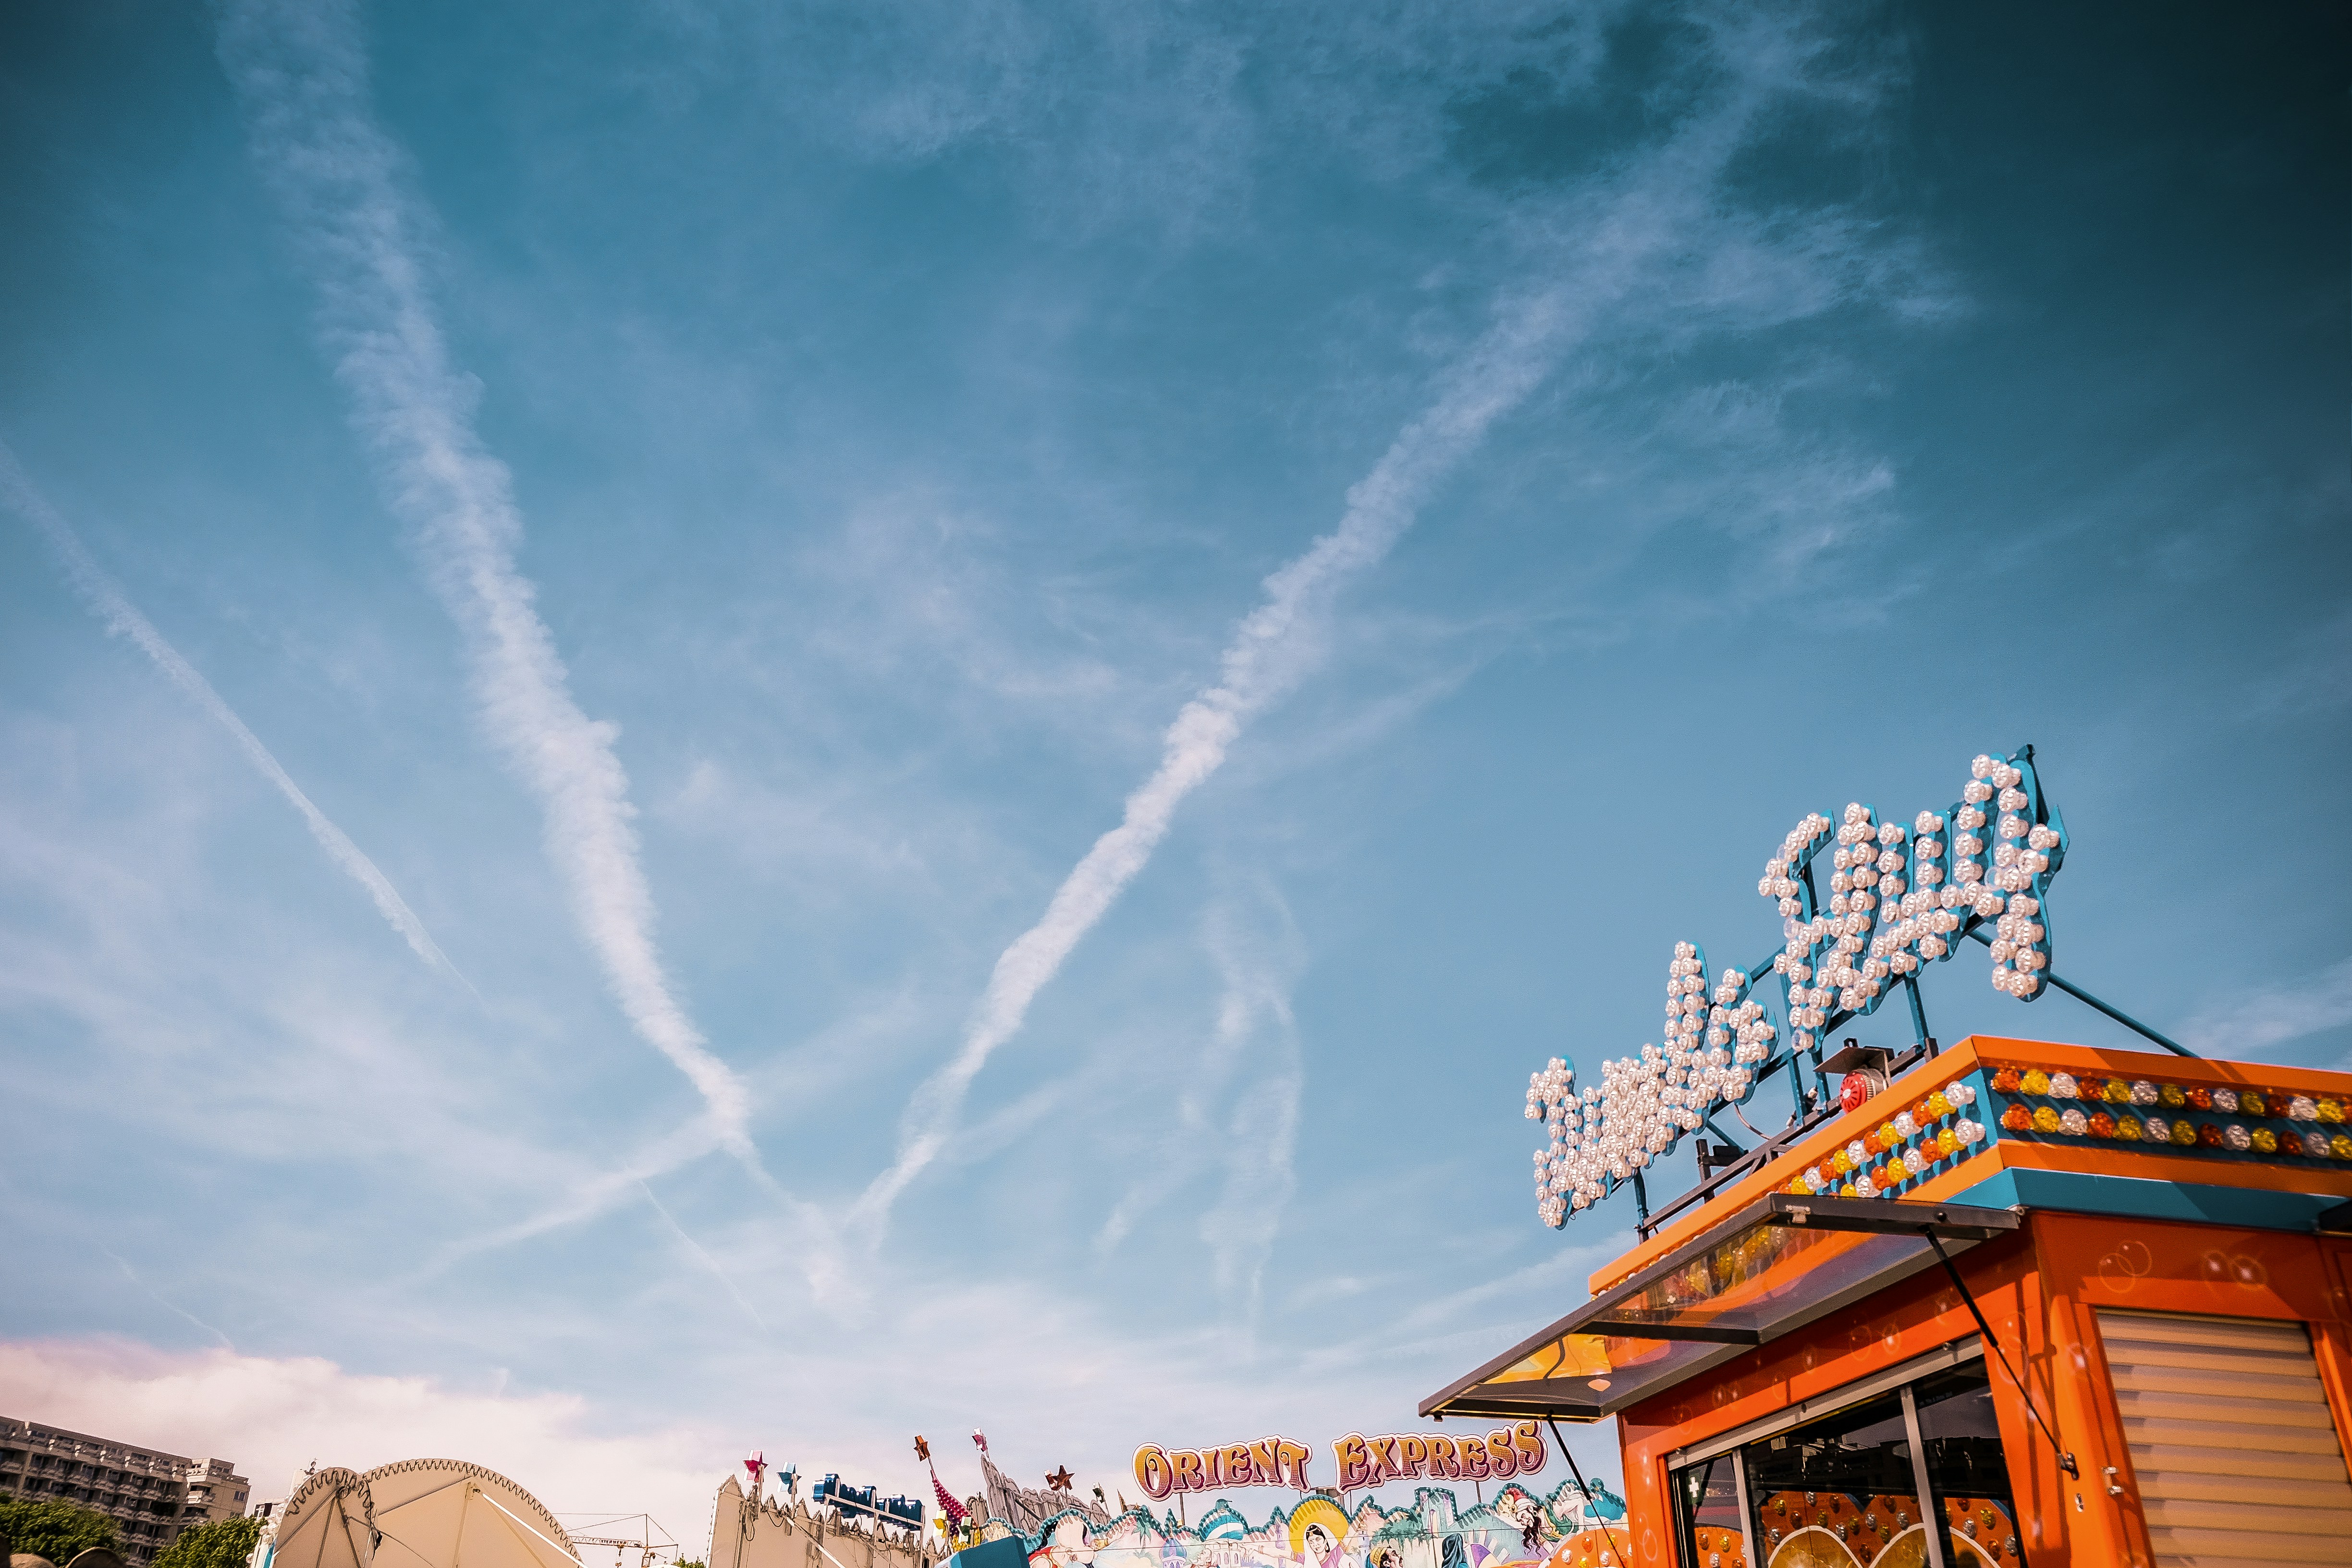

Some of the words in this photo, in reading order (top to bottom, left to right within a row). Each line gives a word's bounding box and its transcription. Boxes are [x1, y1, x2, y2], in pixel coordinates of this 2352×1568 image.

[1758, 752, 2069, 1051] Flug
[1131, 1436, 1311, 1500] ORIENT
[1332, 1420, 1548, 1494] EXPRESS
